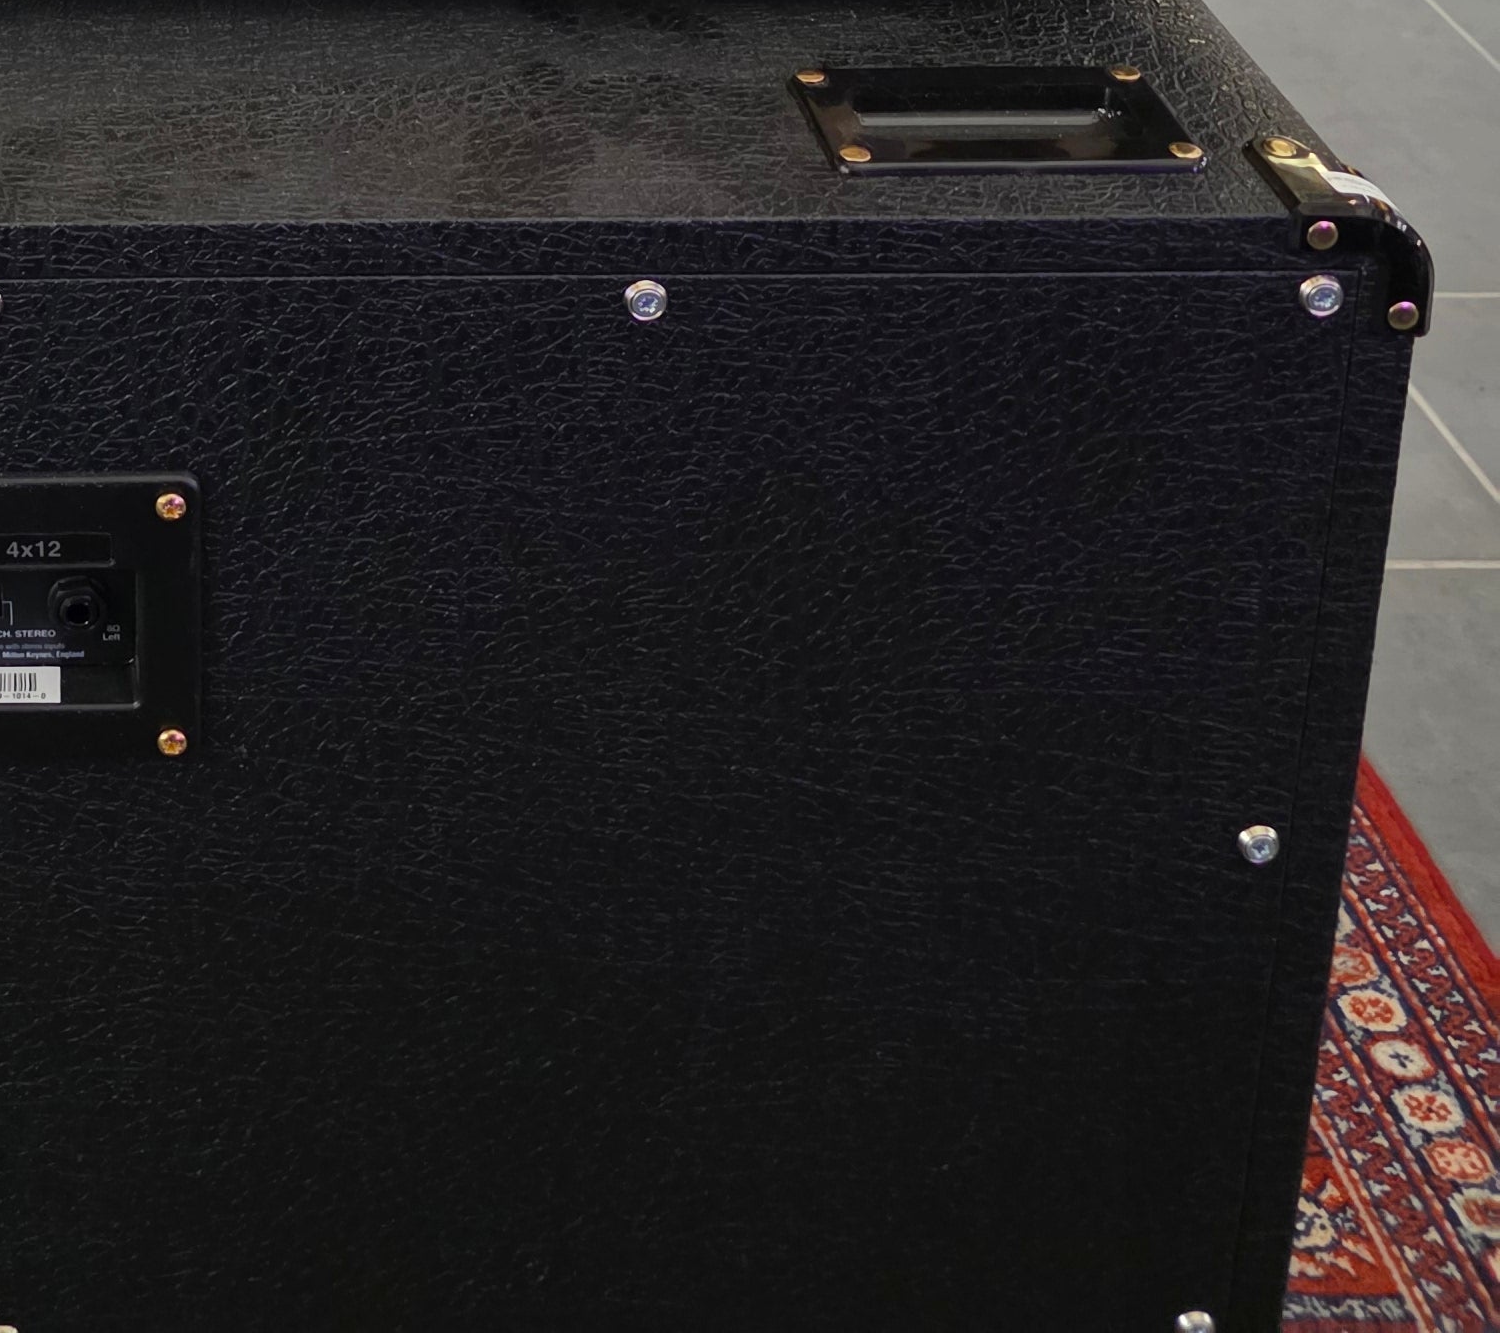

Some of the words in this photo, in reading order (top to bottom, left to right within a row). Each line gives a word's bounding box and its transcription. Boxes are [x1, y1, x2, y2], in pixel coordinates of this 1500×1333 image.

[5, 540, 62, 558] 4x12
[15, 629, 57, 638] STEREO
[102, 633, 121, 642] Left
